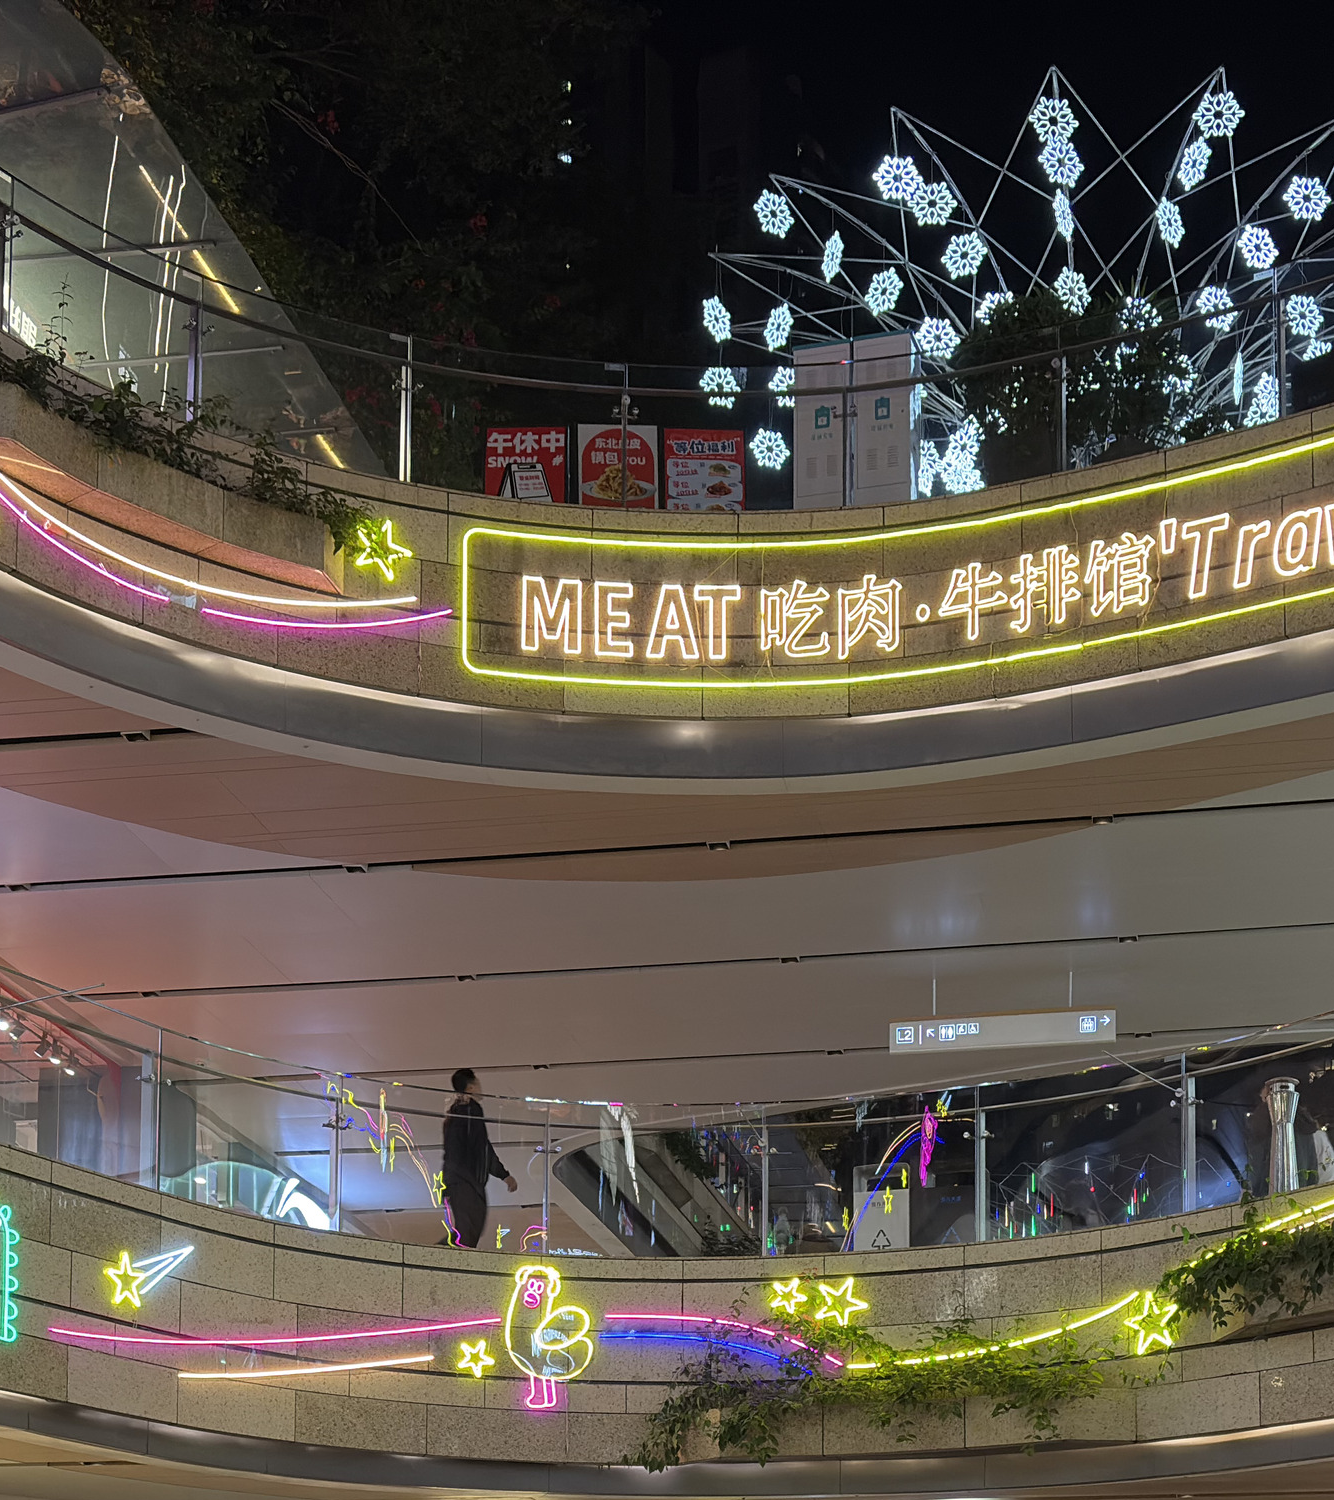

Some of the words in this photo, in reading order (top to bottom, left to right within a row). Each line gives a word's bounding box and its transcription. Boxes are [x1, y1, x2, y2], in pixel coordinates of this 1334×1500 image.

[487, 431, 565, 453] 午休中
[519, 574, 740, 660] MEAT
[898, 1029, 912, 1042] L2
